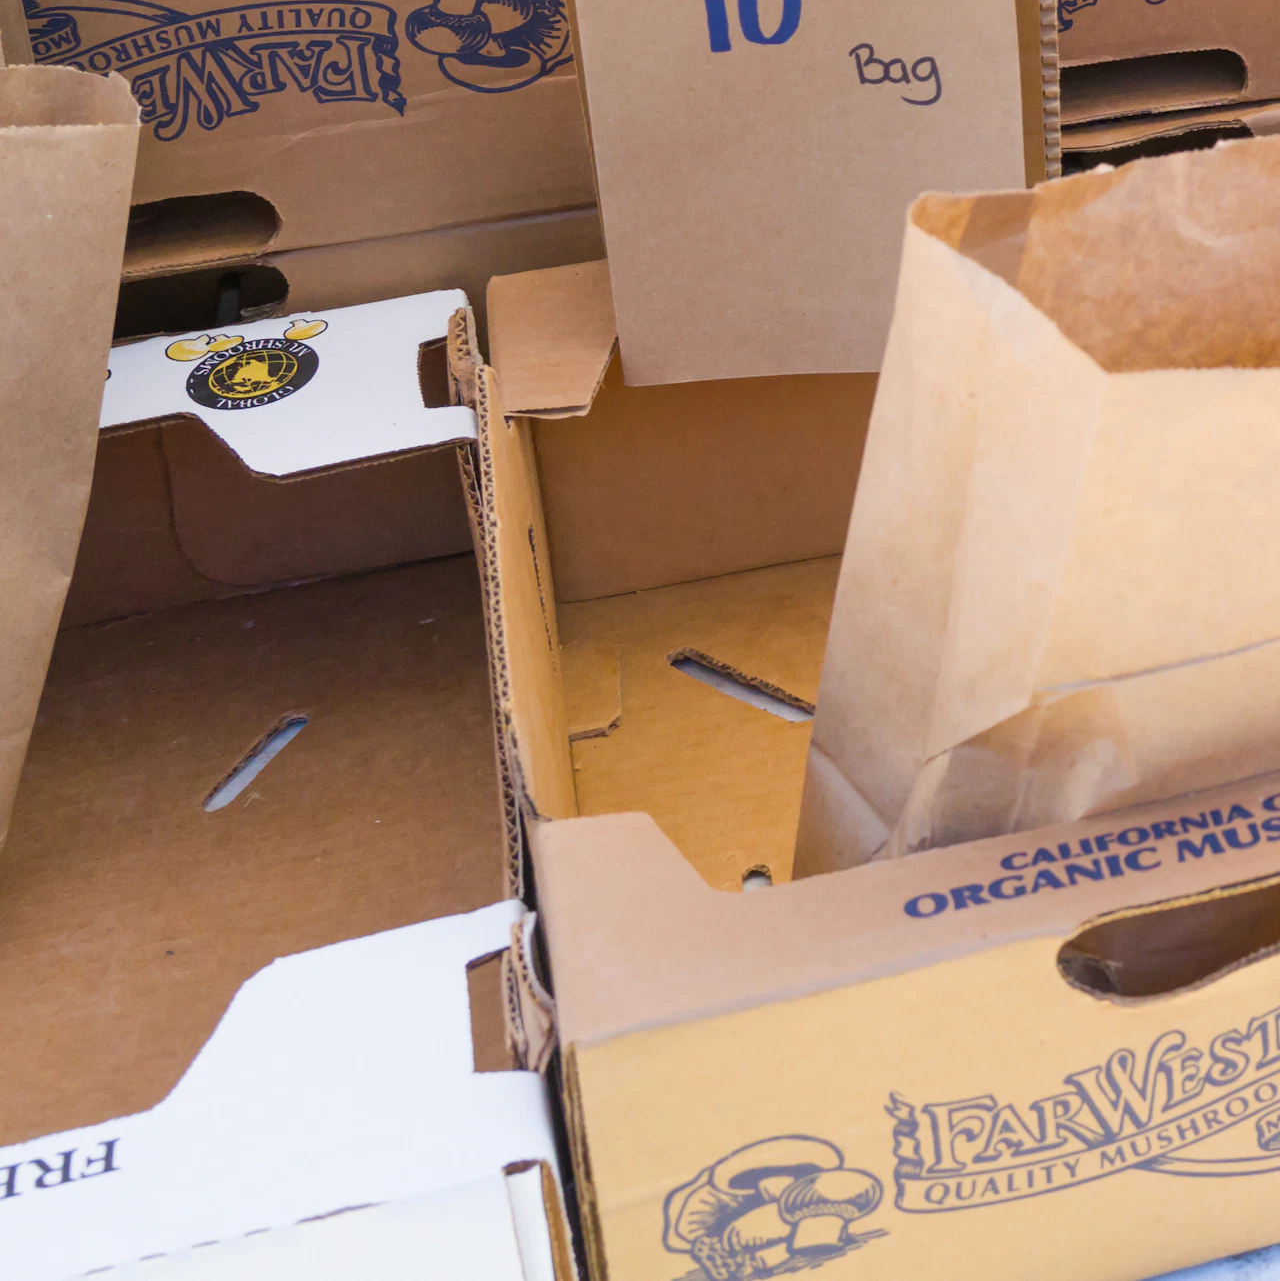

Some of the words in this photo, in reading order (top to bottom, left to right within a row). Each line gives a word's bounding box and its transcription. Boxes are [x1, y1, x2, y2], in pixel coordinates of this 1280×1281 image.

[238, 6, 373, 34] QUALITY
[849, 43, 942, 106] Bag
[194, 339, 311, 376] MUSHROOMS
[217, 385, 294, 409] GLOBAL
[999, 803, 1253, 872] CALIFORNIA
[903, 848, 1162, 920] ORGANIC
[923, 1157, 1080, 1205] QUALITY
